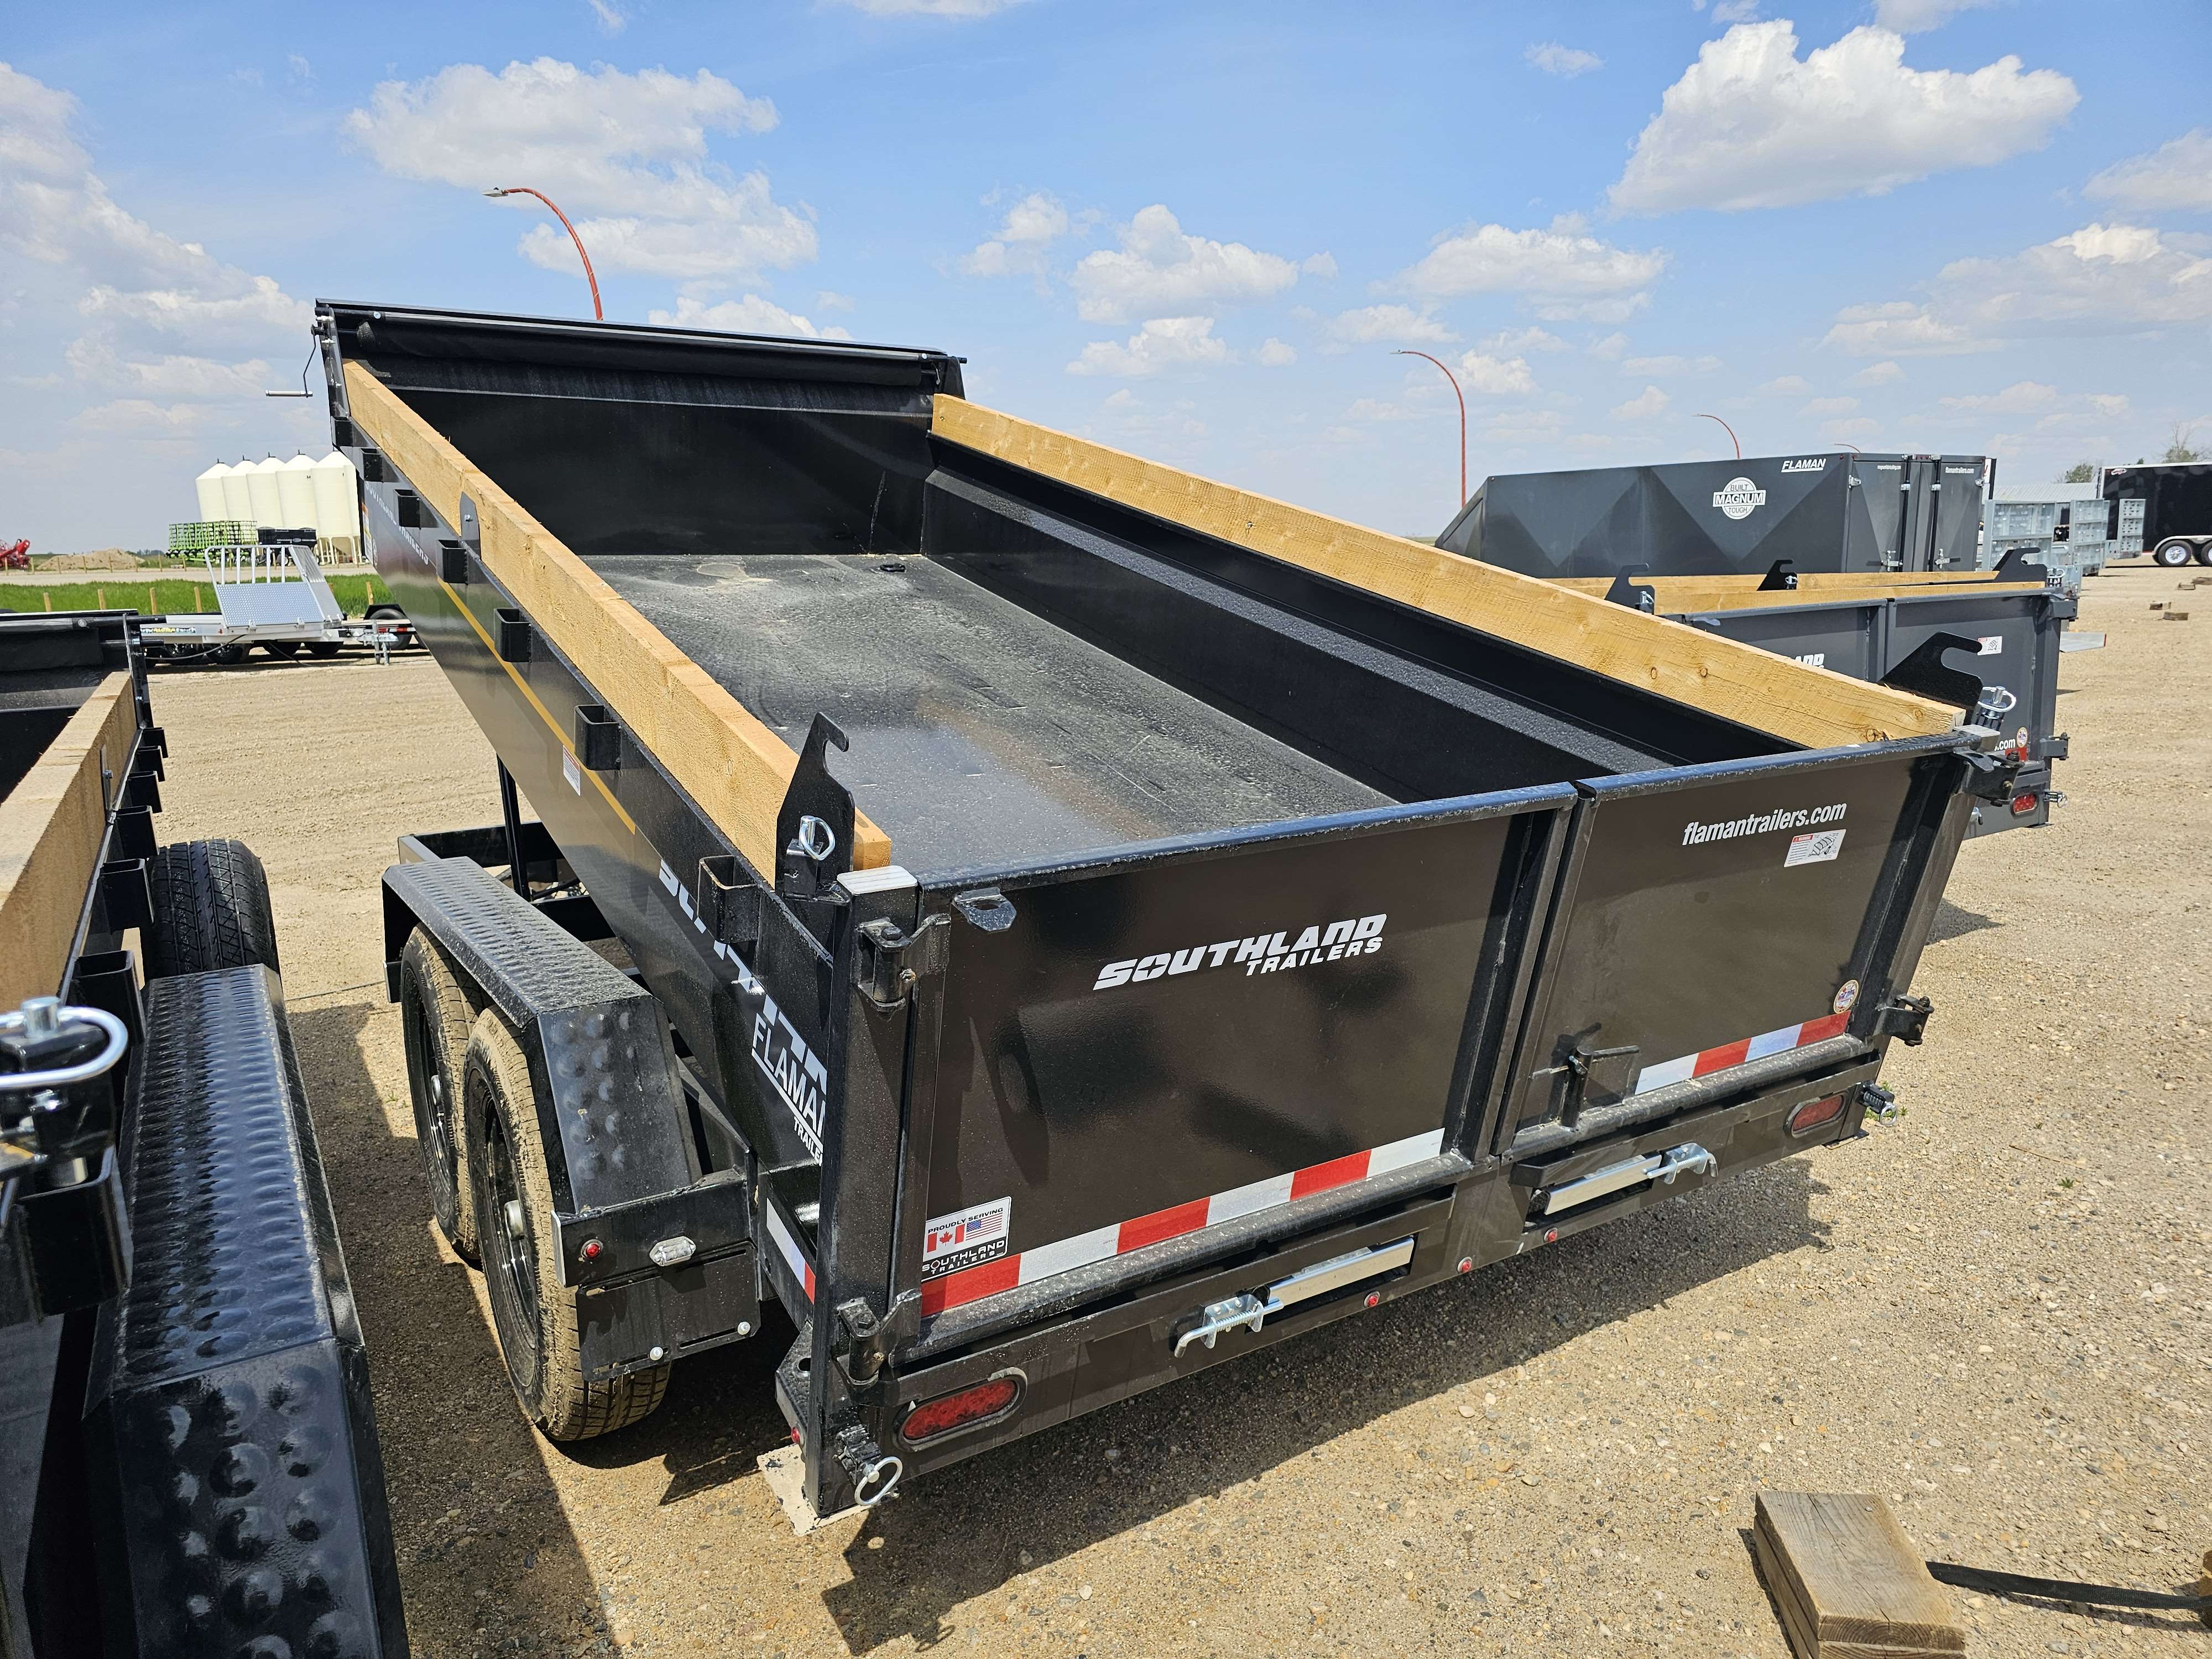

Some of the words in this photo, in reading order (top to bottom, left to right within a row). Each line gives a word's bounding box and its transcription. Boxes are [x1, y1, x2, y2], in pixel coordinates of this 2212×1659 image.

[1782, 458, 1827, 469] FLAMAN
[1715, 493, 1763, 505] MAGNUM
[1682, 803, 1847, 846] flamantrailers.com
[1093, 914, 1387, 990] SOUTHLAND
[1246, 937, 1383, 976] TRAILERS
[794, 1116, 823, 1167] TRAILE
[928, 1218, 967, 1234] PROUDLY
[968, 1207, 1004, 1222] SERVING
[922, 1240, 1005, 1272] SOUTHLAND
[931, 1250, 995, 1275] TRAILERS
